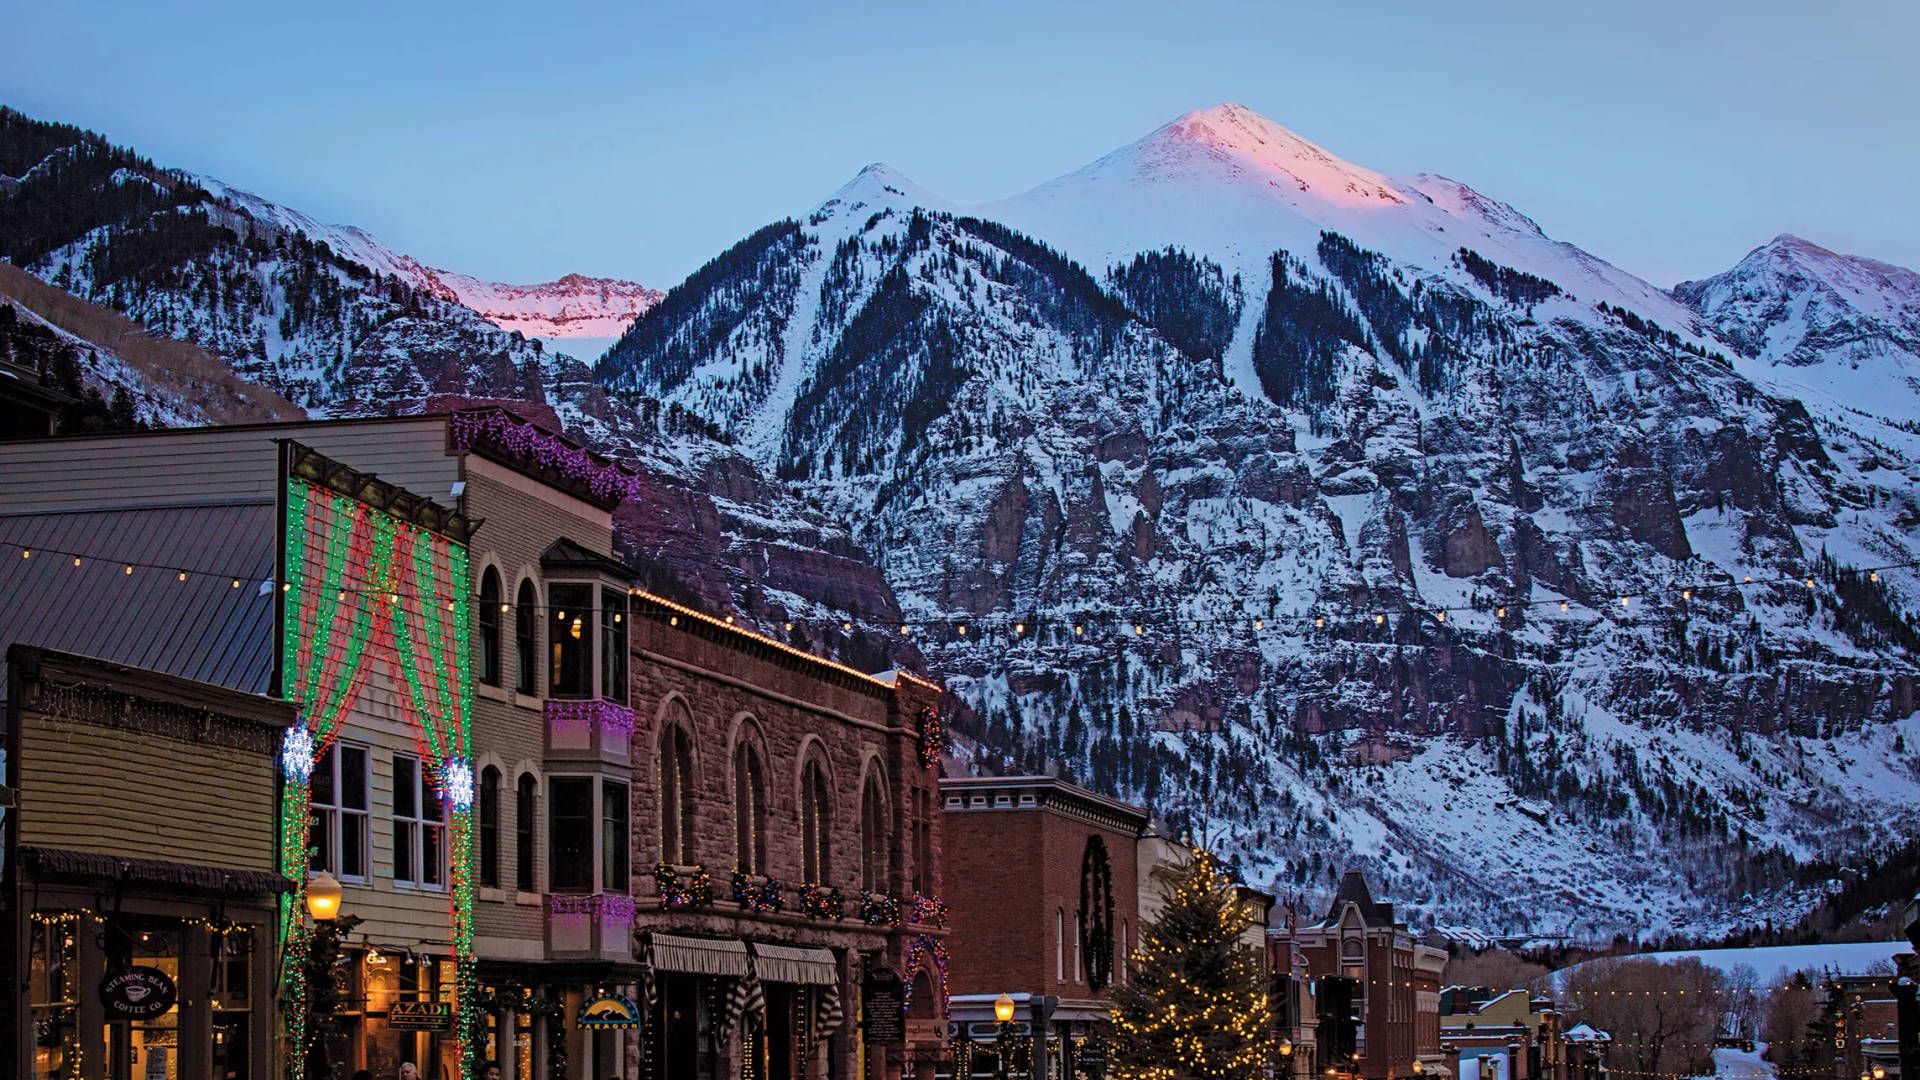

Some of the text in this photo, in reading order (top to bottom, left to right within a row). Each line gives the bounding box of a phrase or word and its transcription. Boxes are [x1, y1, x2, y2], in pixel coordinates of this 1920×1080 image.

[105, 973, 145, 992] STEAMING
[113, 1000, 146, 1014] COFFEE
[391, 1003, 448, 1015] AZADI
